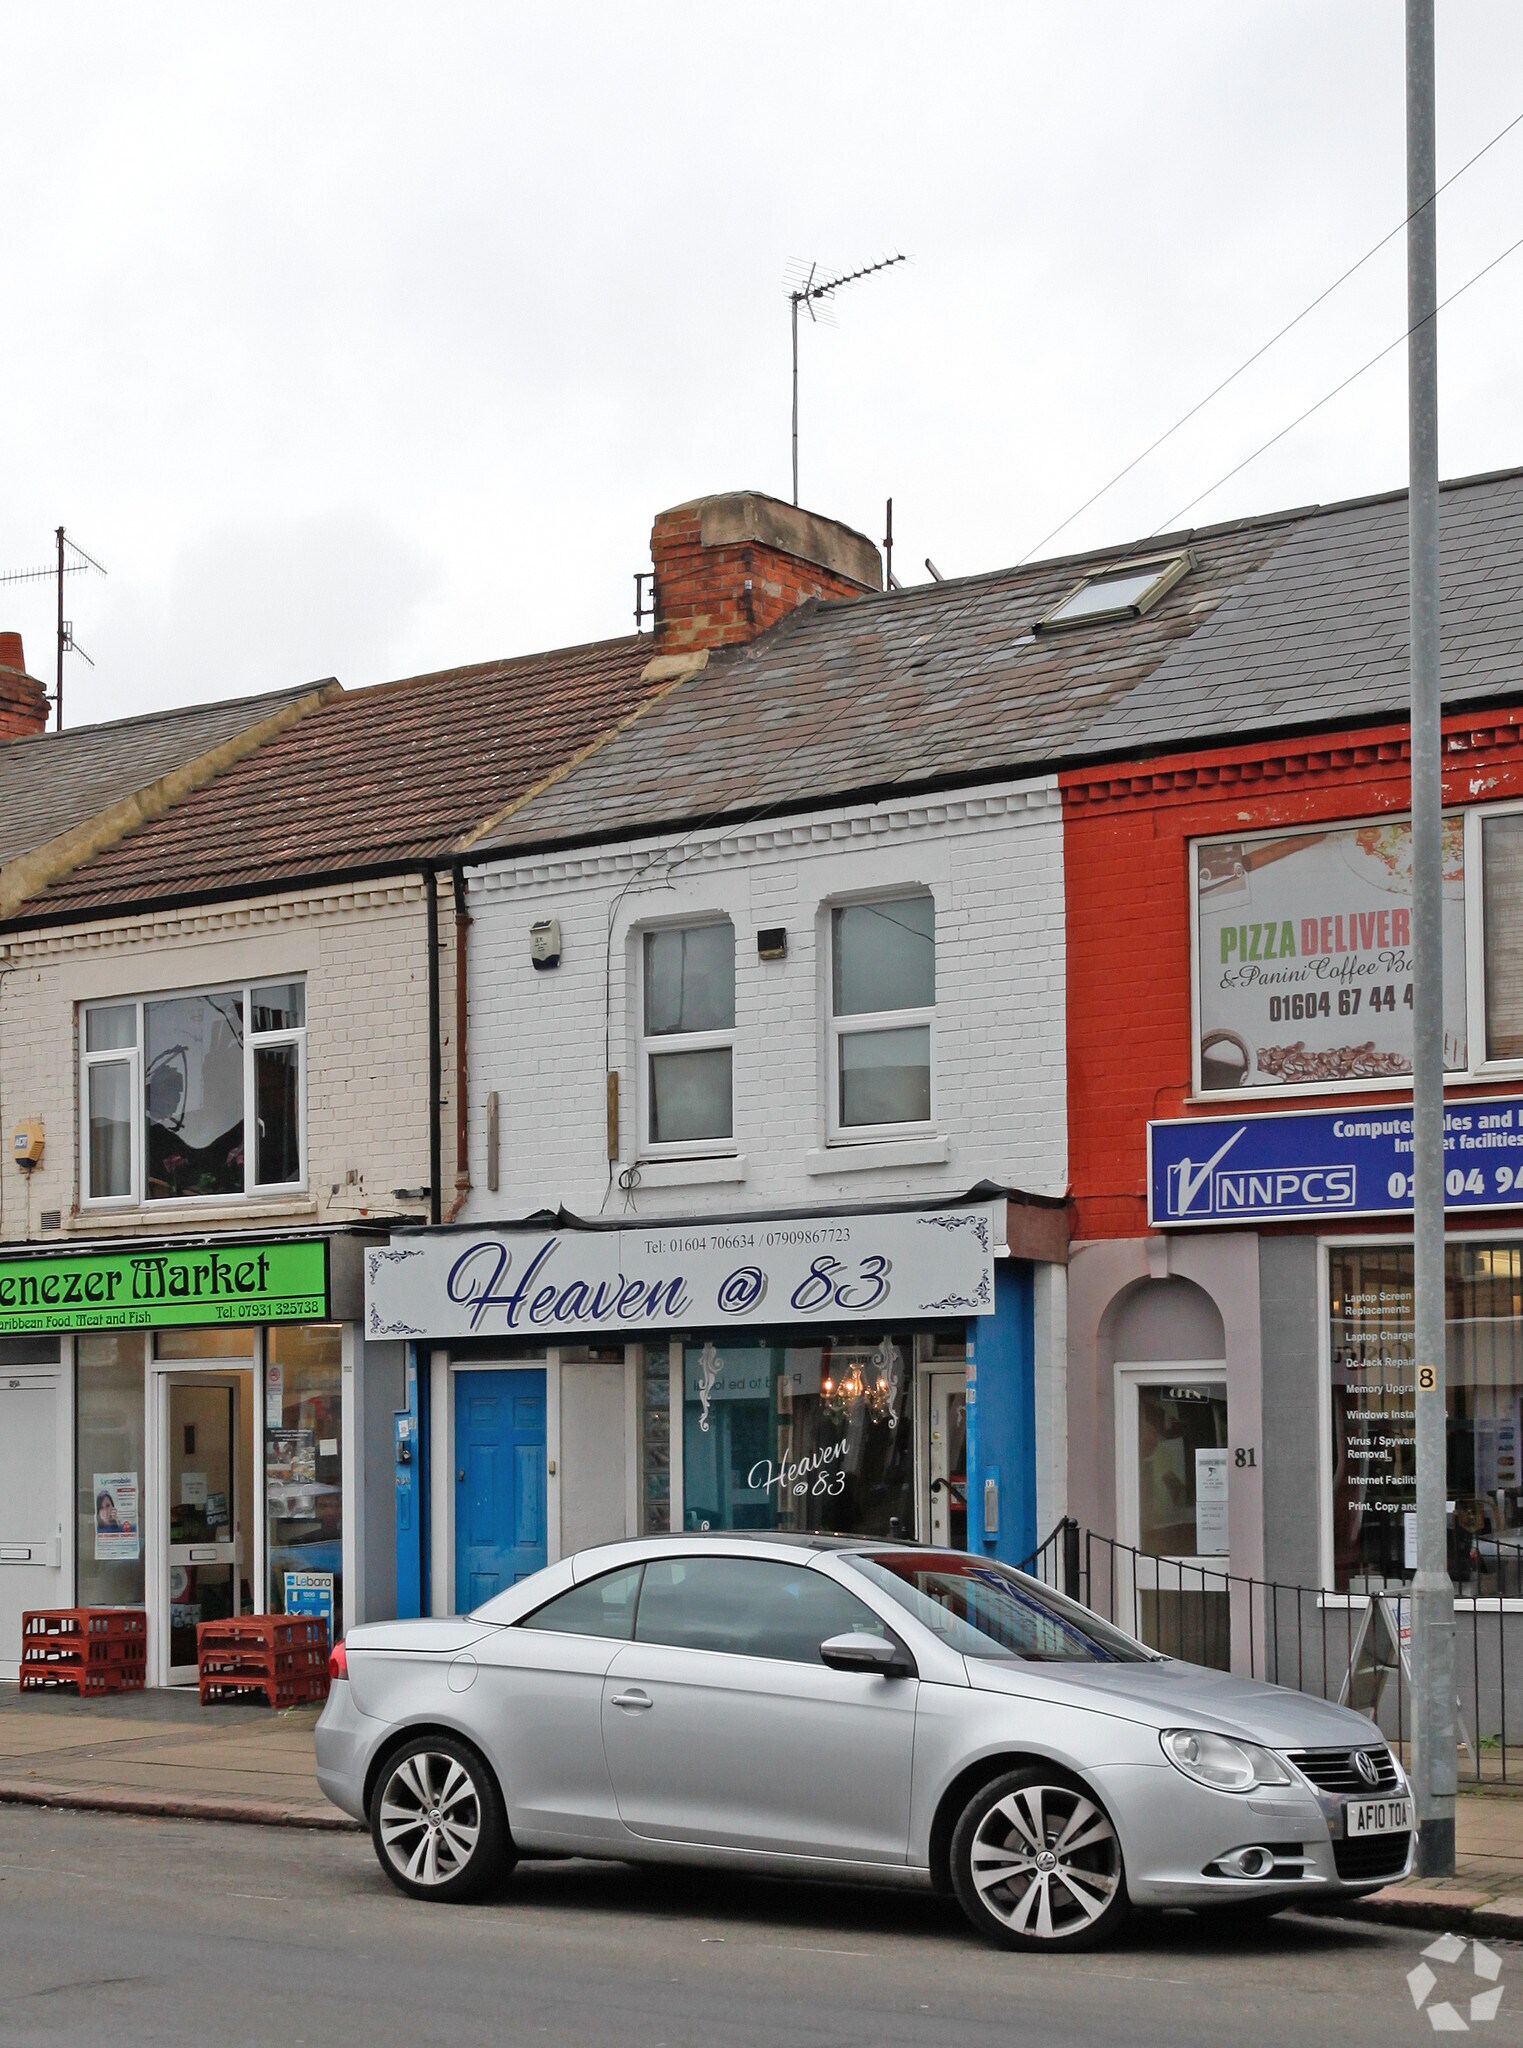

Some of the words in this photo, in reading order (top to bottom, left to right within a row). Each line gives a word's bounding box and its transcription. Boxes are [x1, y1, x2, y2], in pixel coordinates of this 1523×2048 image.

[1220, 920, 1296, 964] PIZZA
[1301, 907, 1414, 957] DELIVER
[1240, 963, 1308, 987] Panini
[1308, 956, 1379, 985] Coffee
[1378, 950, 1414, 973] Ba
[1269, 991, 1331, 1022] 01604
[1338, 988, 1362, 1016] 67
[1369, 985, 1396, 1013] 44
[1403, 983, 1414, 1010] 4
[1478, 1110, 1512, 1129] and
[1460, 1132, 1523, 1149] facilities
[1388, 1168, 1485, 1199] 0104
[644, 1240, 666, 1253] Tel:
[670, 1238, 706, 1252] 01604
[711, 1234, 755, 1249] 706634
[766, 1228, 851, 1246] 07909867723
[0, 1271, 122, 1307] enezer
[130, 1251, 270, 1299] Market
[446, 1238, 693, 1331] Heaven
[717, 1266, 769, 1313] @
[791, 1254, 893, 1314] 83
[1345, 1293, 1377, 1303] Laptop
[1379, 1292, 1412, 1301] Screen
[76, 1314, 103, 1326] Meat
[106, 1312, 125, 1324] and
[129, 1311, 151, 1324] Fish
[216, 1305, 235, 1319] Tel:
[238, 1303, 272, 1317] 07931
[276, 1301, 319, 1315] 325738
[1345, 1305, 1411, 1316] Replacements
[1345, 1332, 1378, 1342] Laptop
[1380, 1331, 1416, 1341] Charge
[1346, 1358, 1359, 1367] Dc
[1361, 1357, 1382, 1367] Jack
[1419, 1368, 1434, 1388] 8
[1169, 1388, 1201, 1399] OPEN
[1346, 1384, 1383, 1395] Memory
[1385, 1383, 1416, 1394] Upgra
[1346, 1411, 1389, 1420] Windows
[1347, 1437, 1371, 1446] Virus
[1235, 1448, 1257, 1468] 81
[1347, 1449, 1388, 1459] Removal
[748, 1438, 850, 1496] Heaven
[793, 1482, 808, 1496] @
[812, 1470, 845, 1496] 83
[1348, 1475, 1384, 1485] Internet
[1385, 1475, 1417, 1485] Faciliti
[1375, 1501, 1399, 1513] Copy
[295, 1575, 332, 1587] Lebara
[1357, 1804, 1386, 1831] AF10
[1388, 1802, 1407, 1827] TOA
